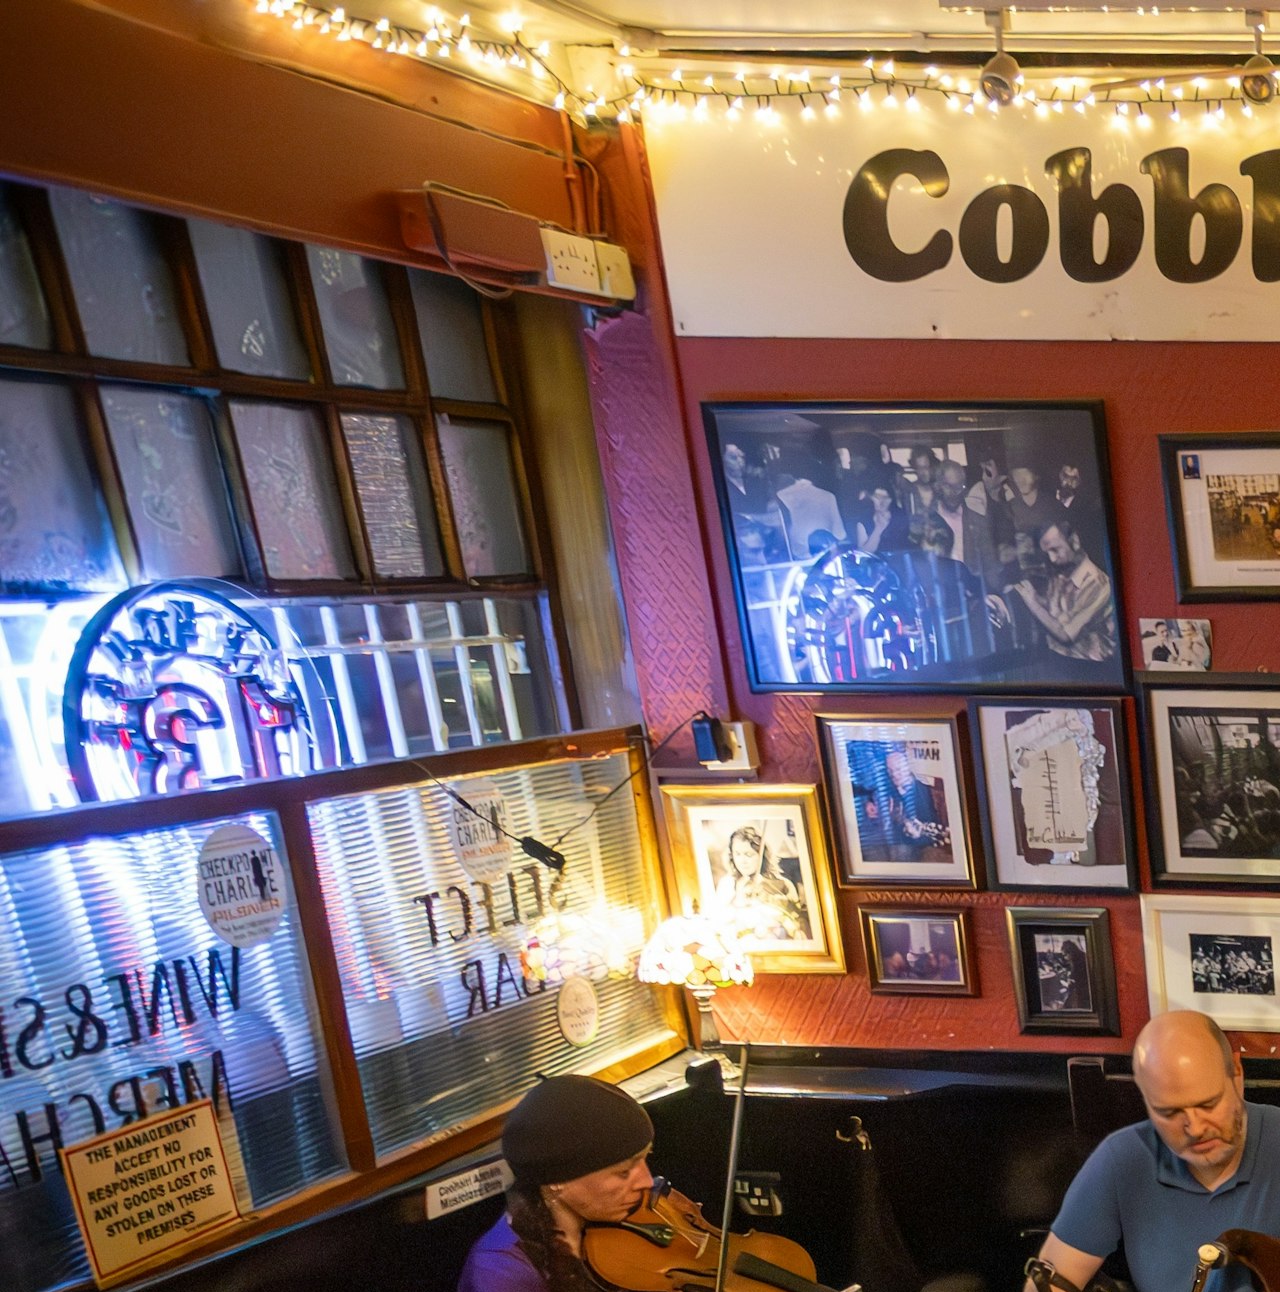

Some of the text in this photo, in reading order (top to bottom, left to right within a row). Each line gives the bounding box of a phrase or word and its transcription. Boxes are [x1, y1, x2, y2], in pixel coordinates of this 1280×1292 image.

[85, 1114, 197, 1164] THE MANAGEMENT
[114, 1140, 182, 1175] ACCEPT NO
[86, 1147, 213, 1206] RESPONSIBILITY FOR
[94, 1164, 218, 1224] ANY GOODS LOST OR
[105, 1184, 216, 1238] STOLEN ON THESE
[137, 1211, 197, 1245] PREMISES
